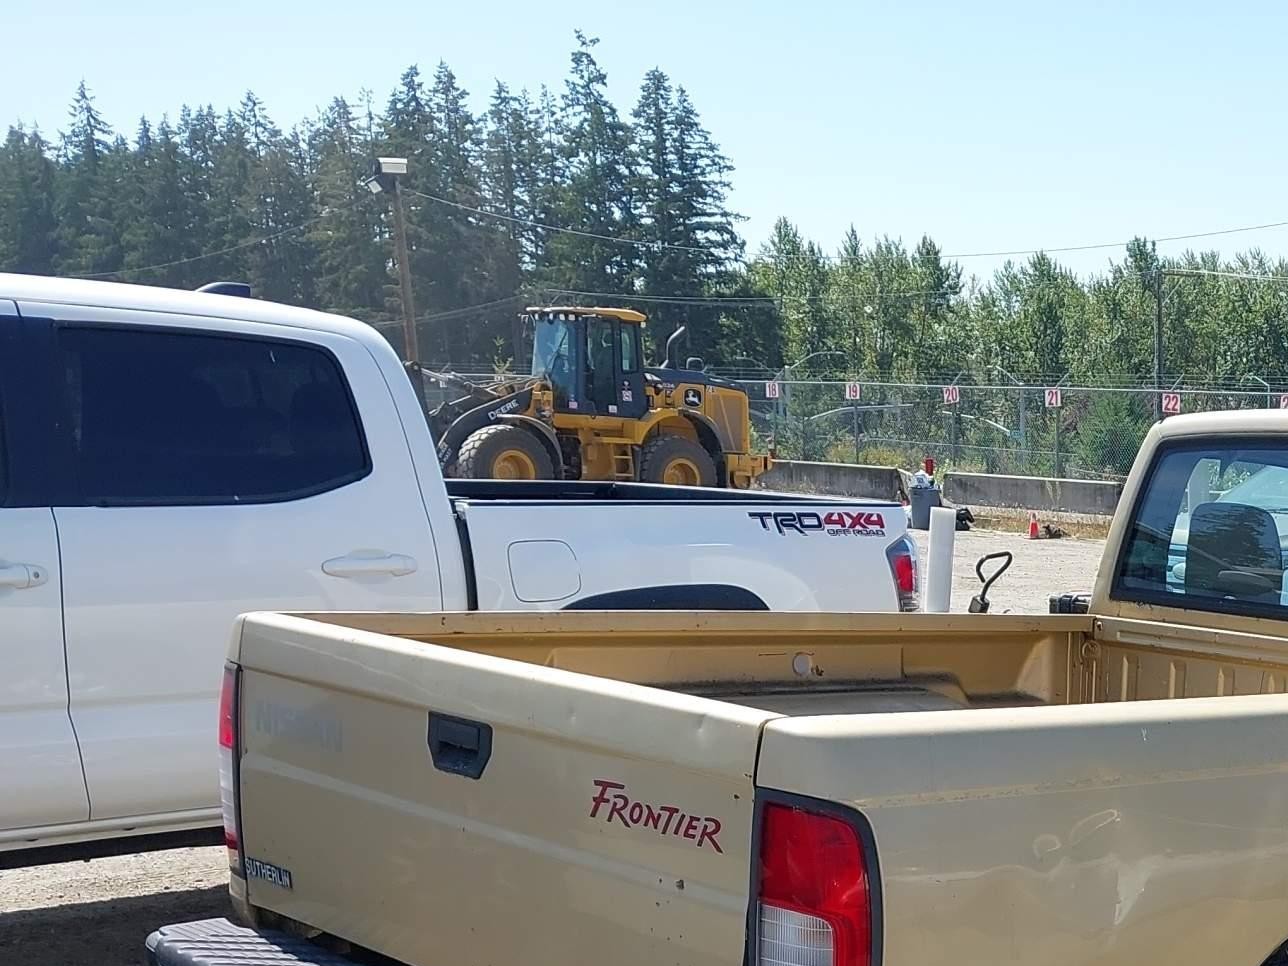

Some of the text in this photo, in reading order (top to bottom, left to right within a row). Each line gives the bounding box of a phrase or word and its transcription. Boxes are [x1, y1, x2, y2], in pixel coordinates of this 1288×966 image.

[767, 383, 778, 397] 18
[849, 383, 859, 399] 19
[945, 387, 958, 402] 20
[1047, 390, 1060, 406] 21
[487, 399, 520, 421] DEERE
[1163, 394, 1179, 412] 22
[590, 779, 724, 854] FRONTIER
